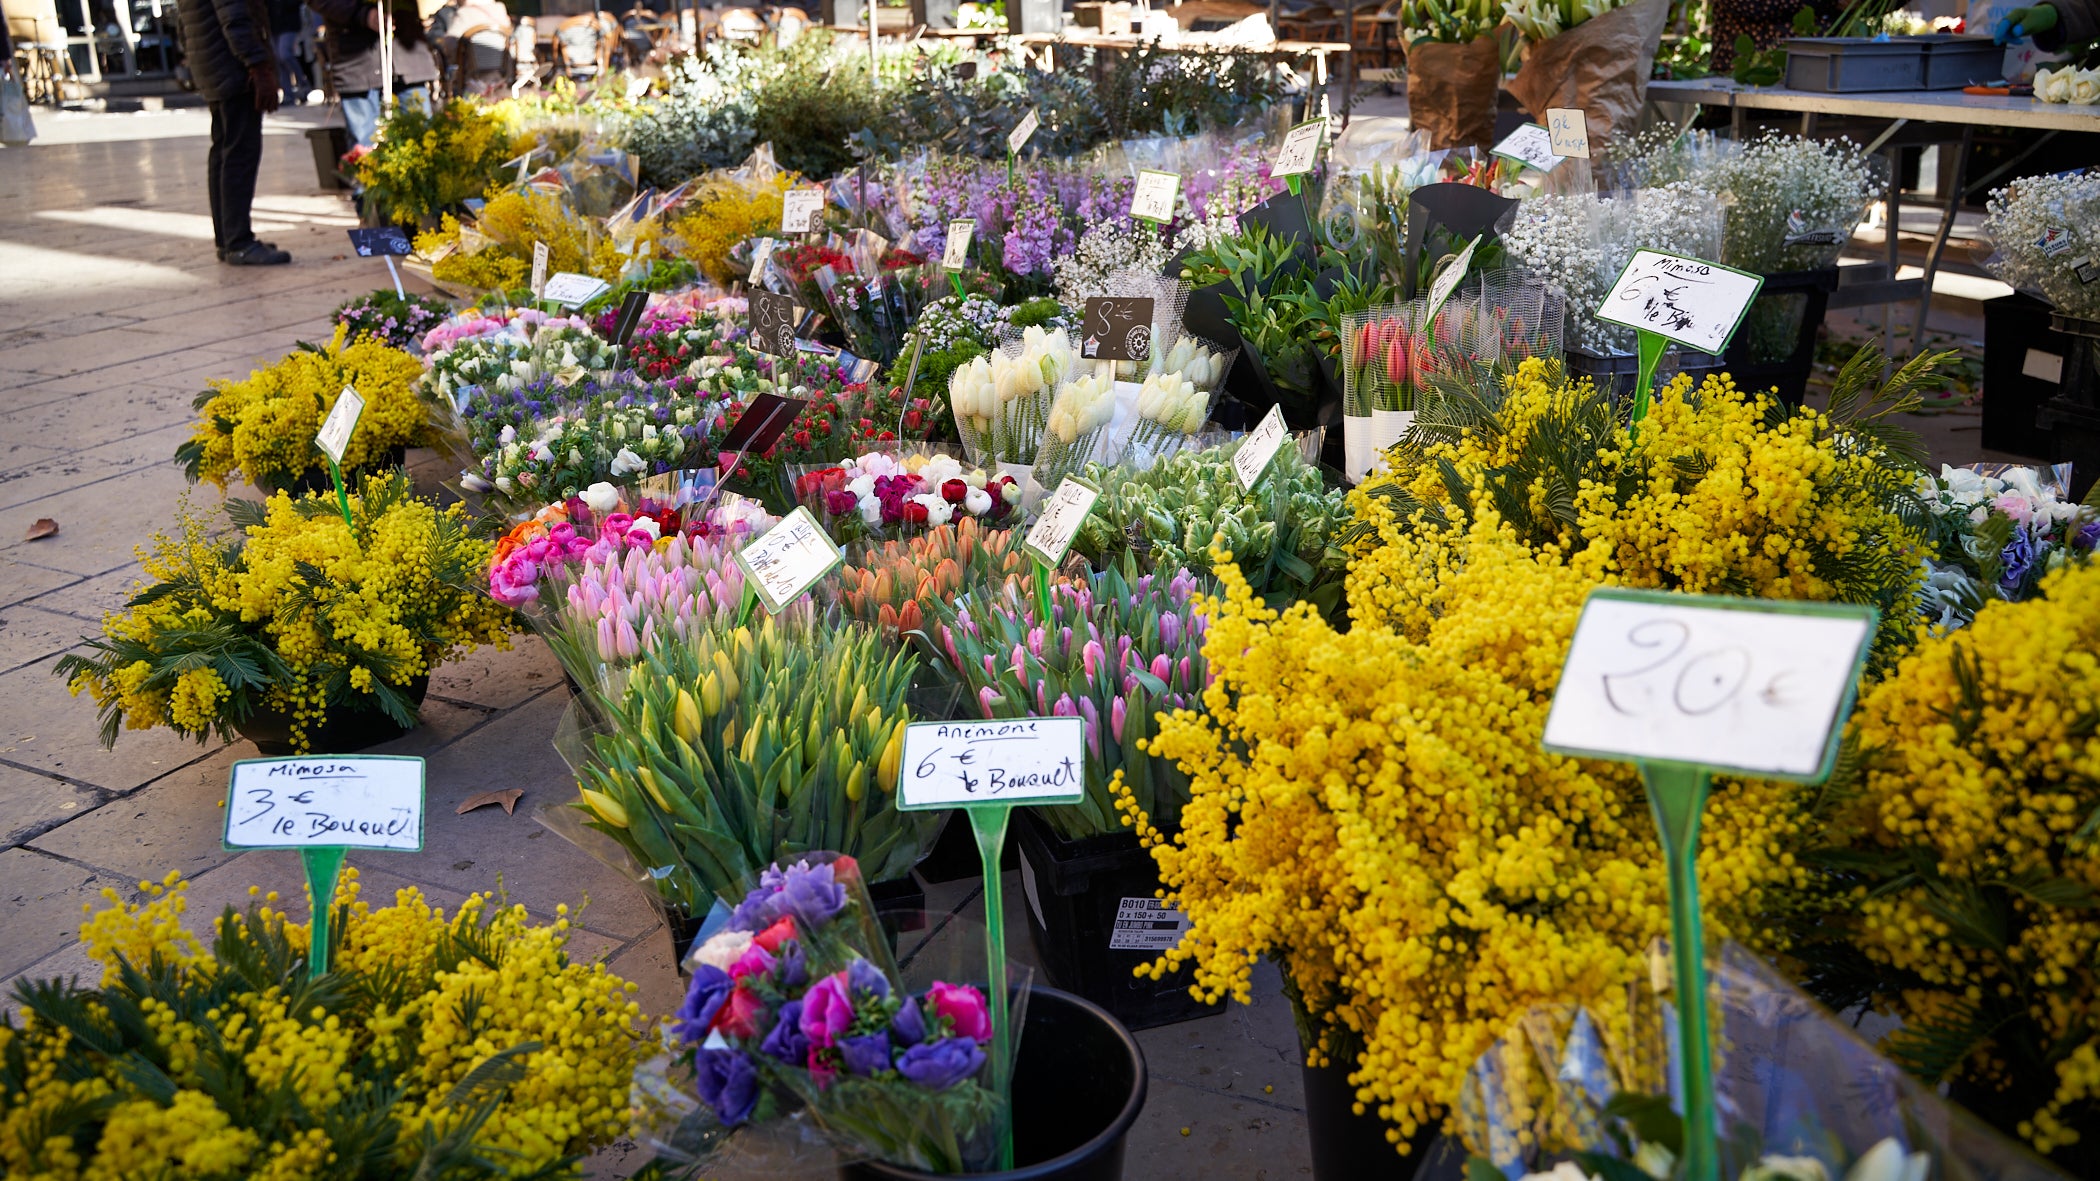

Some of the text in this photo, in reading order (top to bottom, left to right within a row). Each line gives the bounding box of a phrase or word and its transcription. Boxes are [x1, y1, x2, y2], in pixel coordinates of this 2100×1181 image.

[1653, 258, 1710, 275] Mimosa
[1620, 276, 1659, 300] 6
[268, 763, 357, 777] Mimosa
[916, 747, 976, 778] 6 €
[988, 756, 1076, 794] Bouquet
[239, 788, 315, 825] 3 €
[272, 816, 295, 836] le
[1121, 899, 1145, 909] B010
